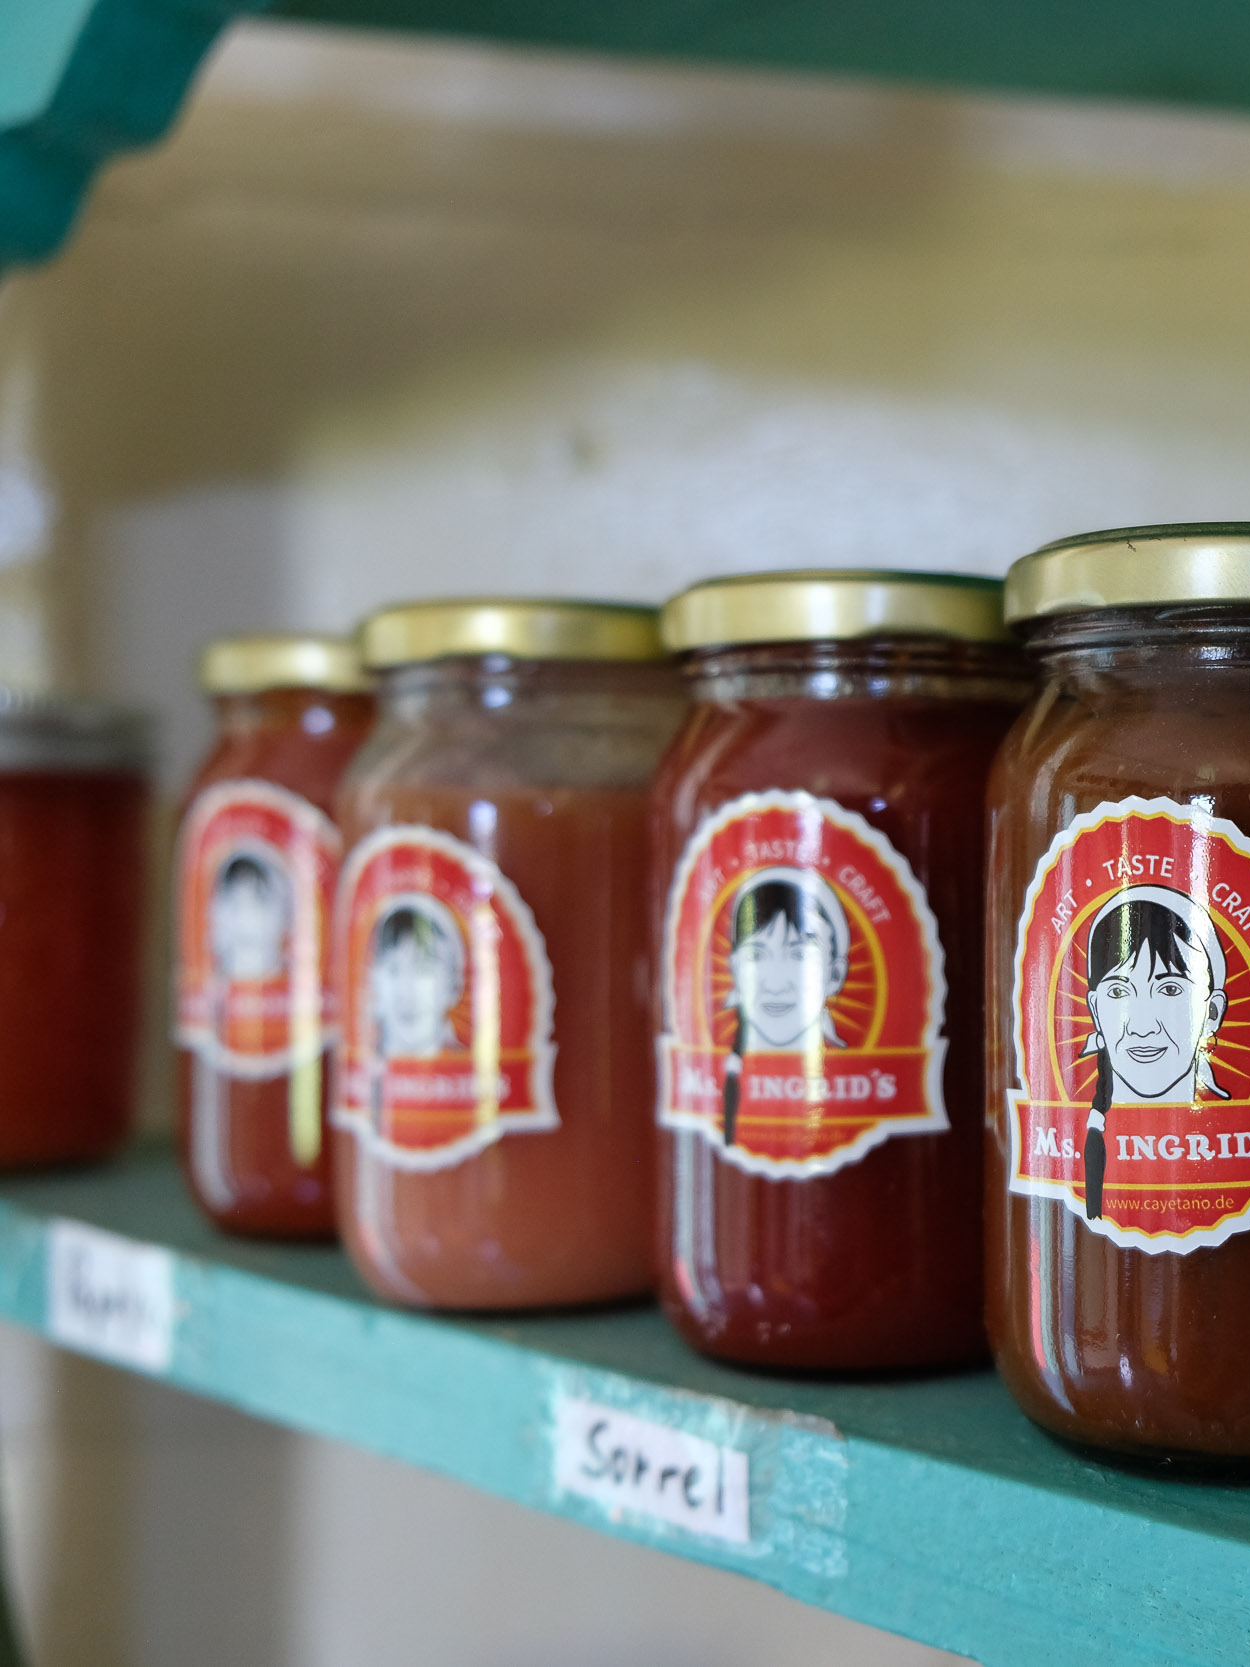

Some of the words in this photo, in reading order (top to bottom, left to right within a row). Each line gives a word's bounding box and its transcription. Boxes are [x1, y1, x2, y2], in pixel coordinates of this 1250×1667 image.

[837, 864, 893, 924] CRAFT
[1050, 888, 1078, 935] ART
[1102, 854, 1175, 881] TASTE
[1034, 1126, 1082, 1159] Ms.
[1105, 1194, 1235, 1215] www.cayetano.de
[581, 1418, 726, 1515] Sorrel
